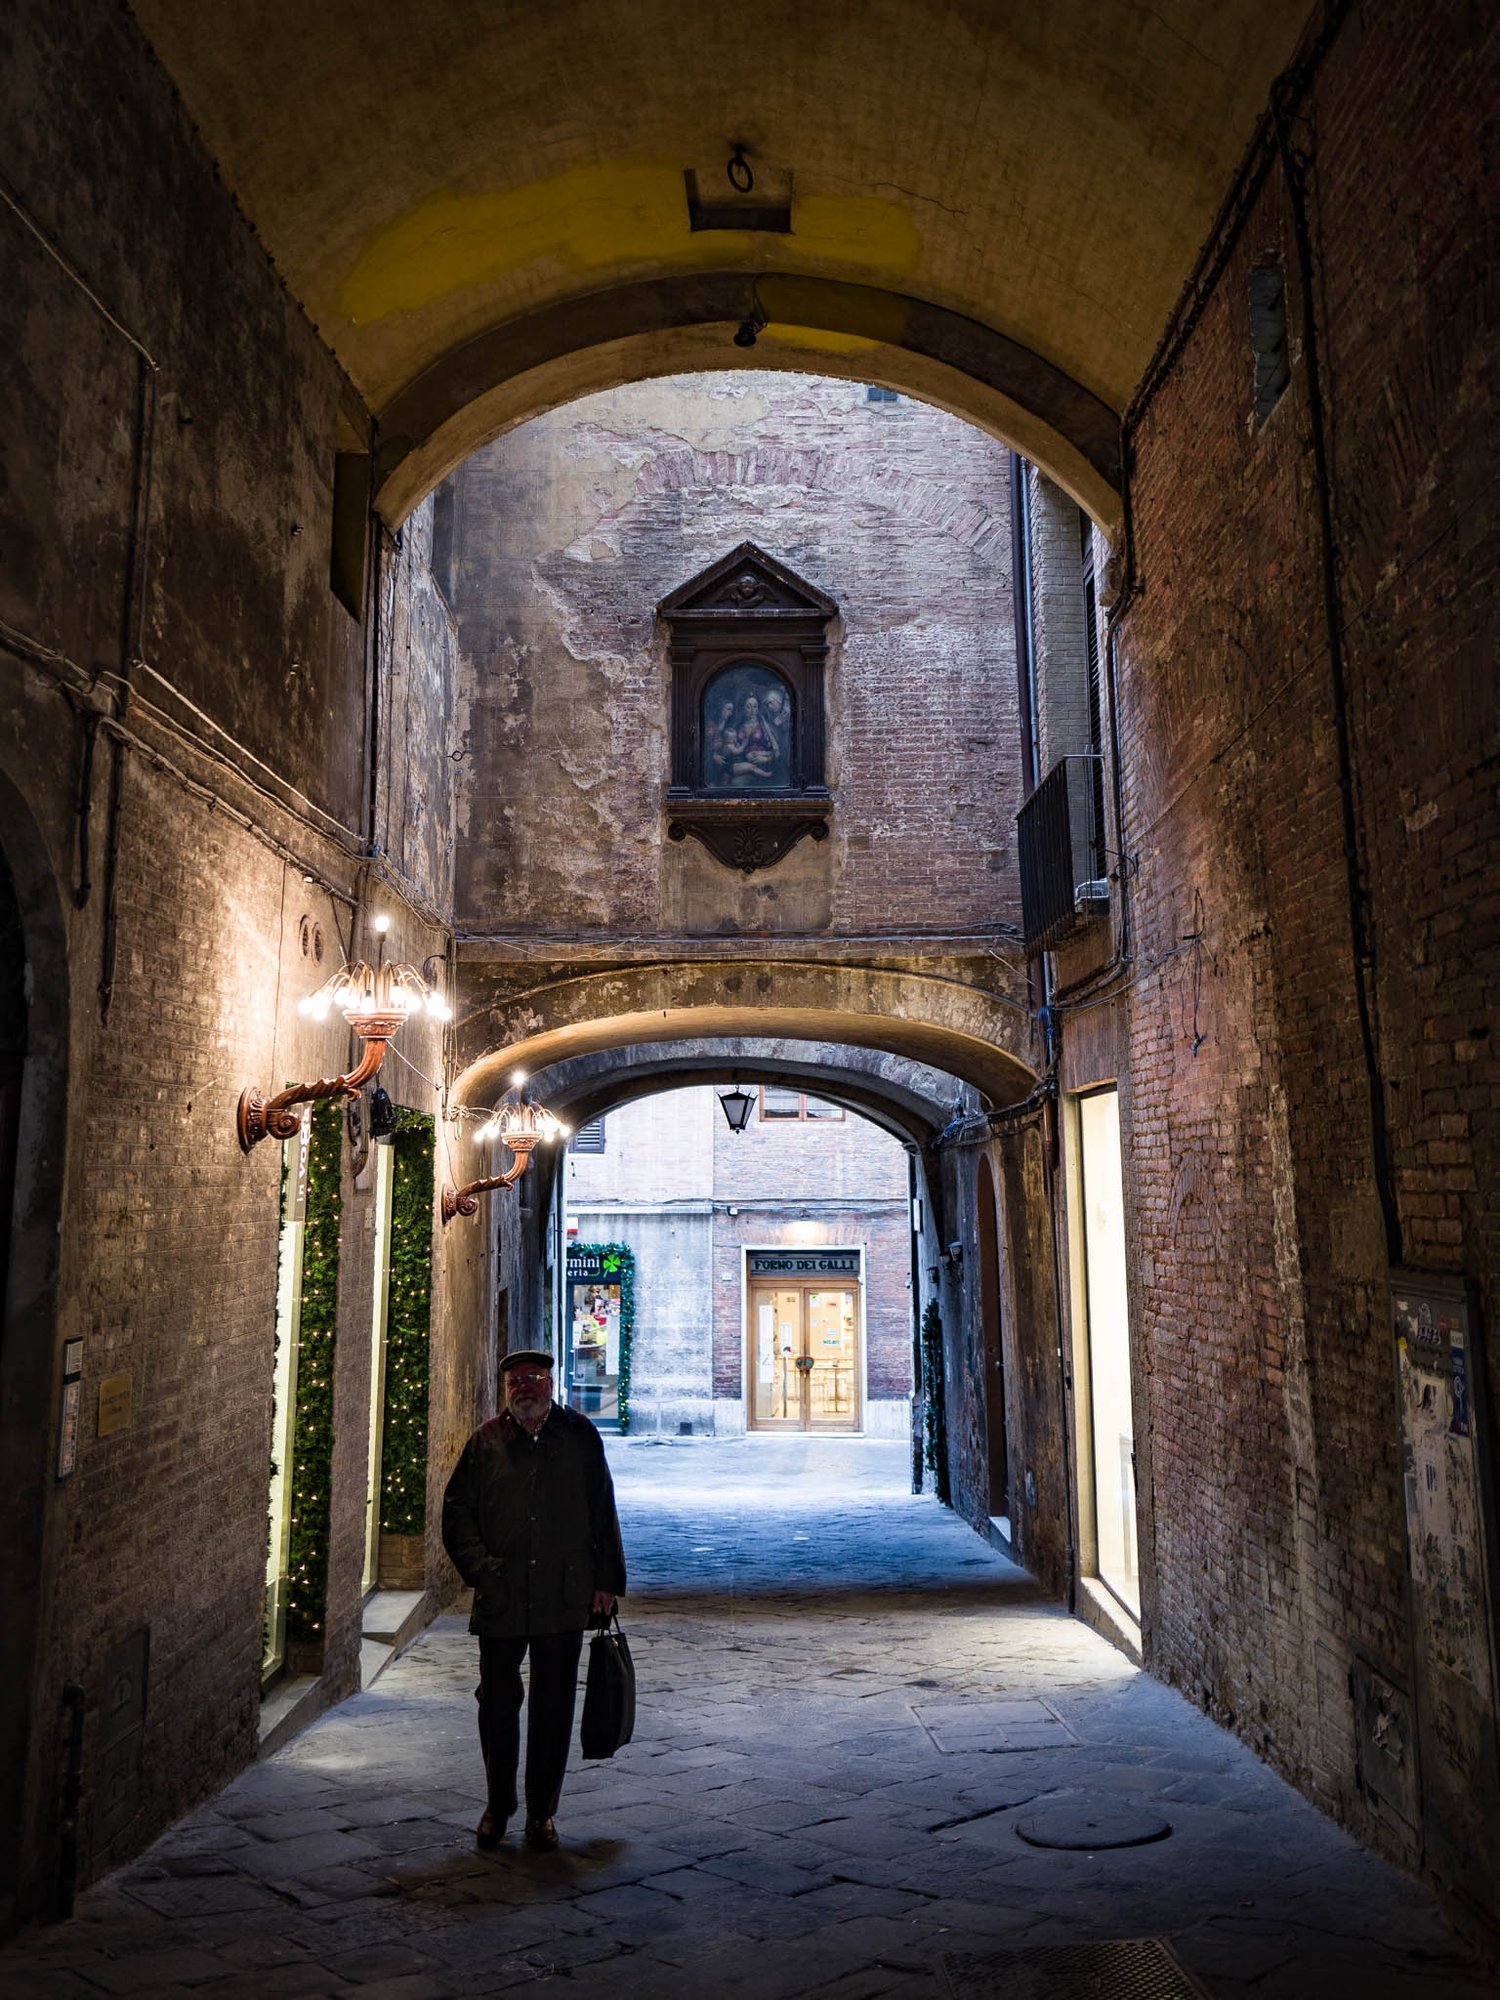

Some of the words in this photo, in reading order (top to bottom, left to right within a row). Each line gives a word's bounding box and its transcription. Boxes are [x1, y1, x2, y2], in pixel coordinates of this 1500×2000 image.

[755, 1260, 793, 1270] FORNO
[796, 1260, 816, 1270] DEI
[819, 1260, 854, 1270] GALLI
